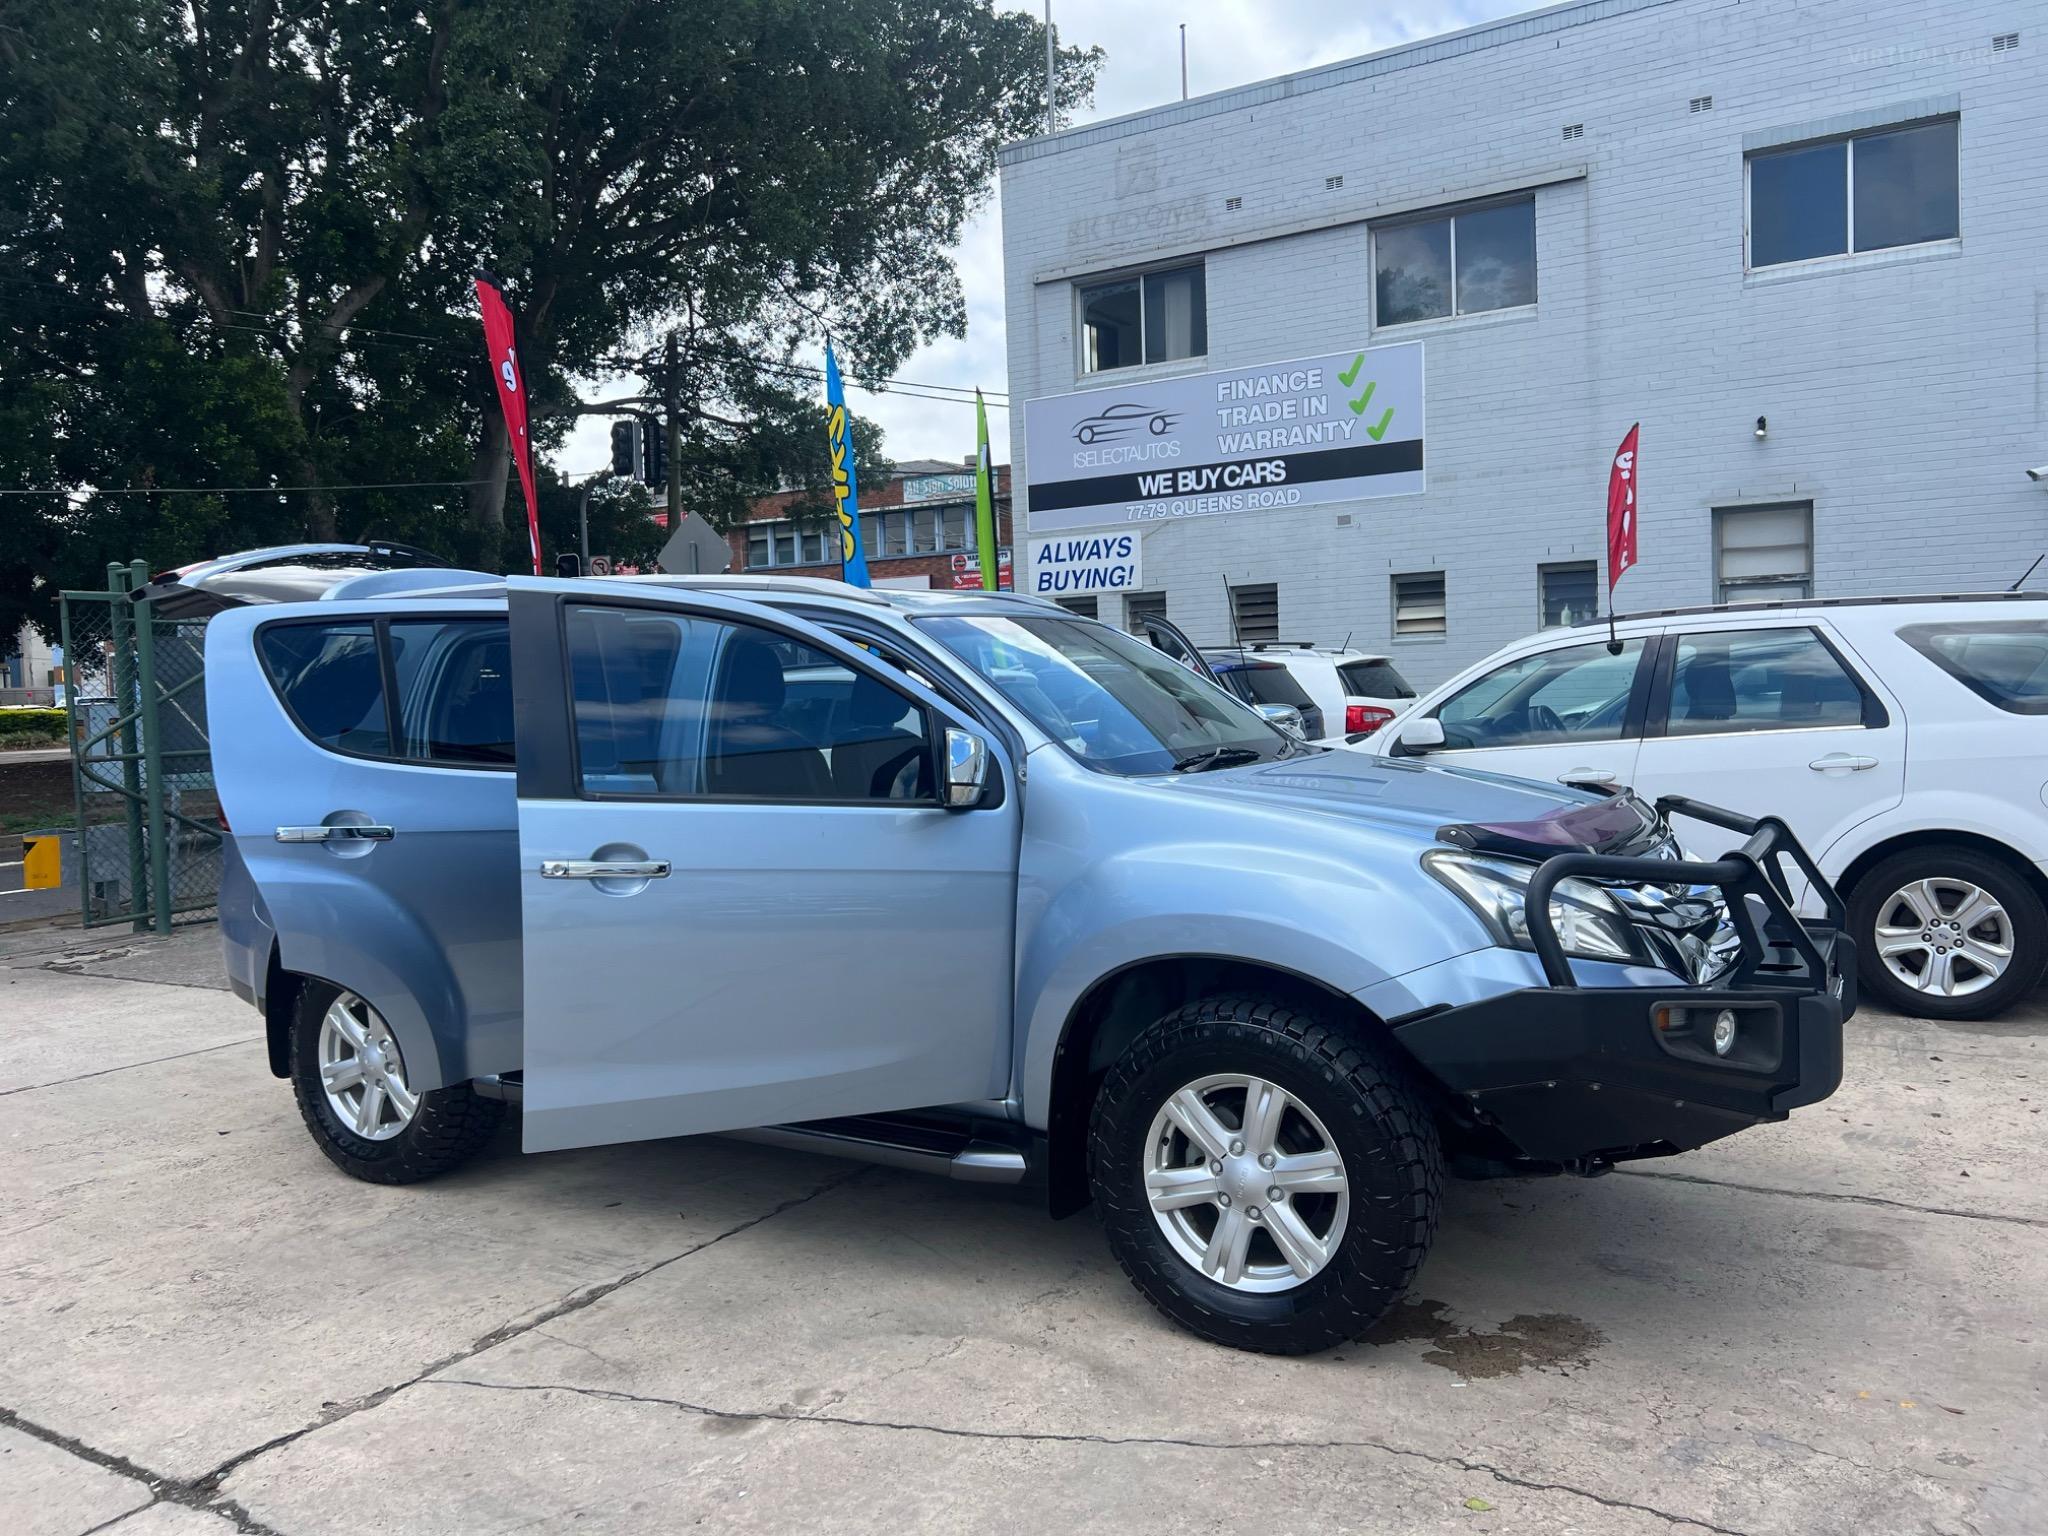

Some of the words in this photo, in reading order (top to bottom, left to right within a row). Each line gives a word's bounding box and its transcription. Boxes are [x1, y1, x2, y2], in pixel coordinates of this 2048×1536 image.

[1217, 368, 1322, 402] FINANCE
[1217, 399, 1297, 428] TRADE
[1303, 394, 1328, 417] IN
[1217, 417, 1357, 454] WARRANTY
[1138, 473, 1173, 497] WE
[1178, 467, 1223, 493] BUY
[1223, 460, 1287, 486] CARS
[1126, 502, 1167, 520] 77-79
[1171, 494, 1243, 516] QUEENS
[1247, 488, 1301, 509] ROAD
[1037, 536, 1132, 564] ALWAYS
[1038, 565, 1134, 592] BUYING!
